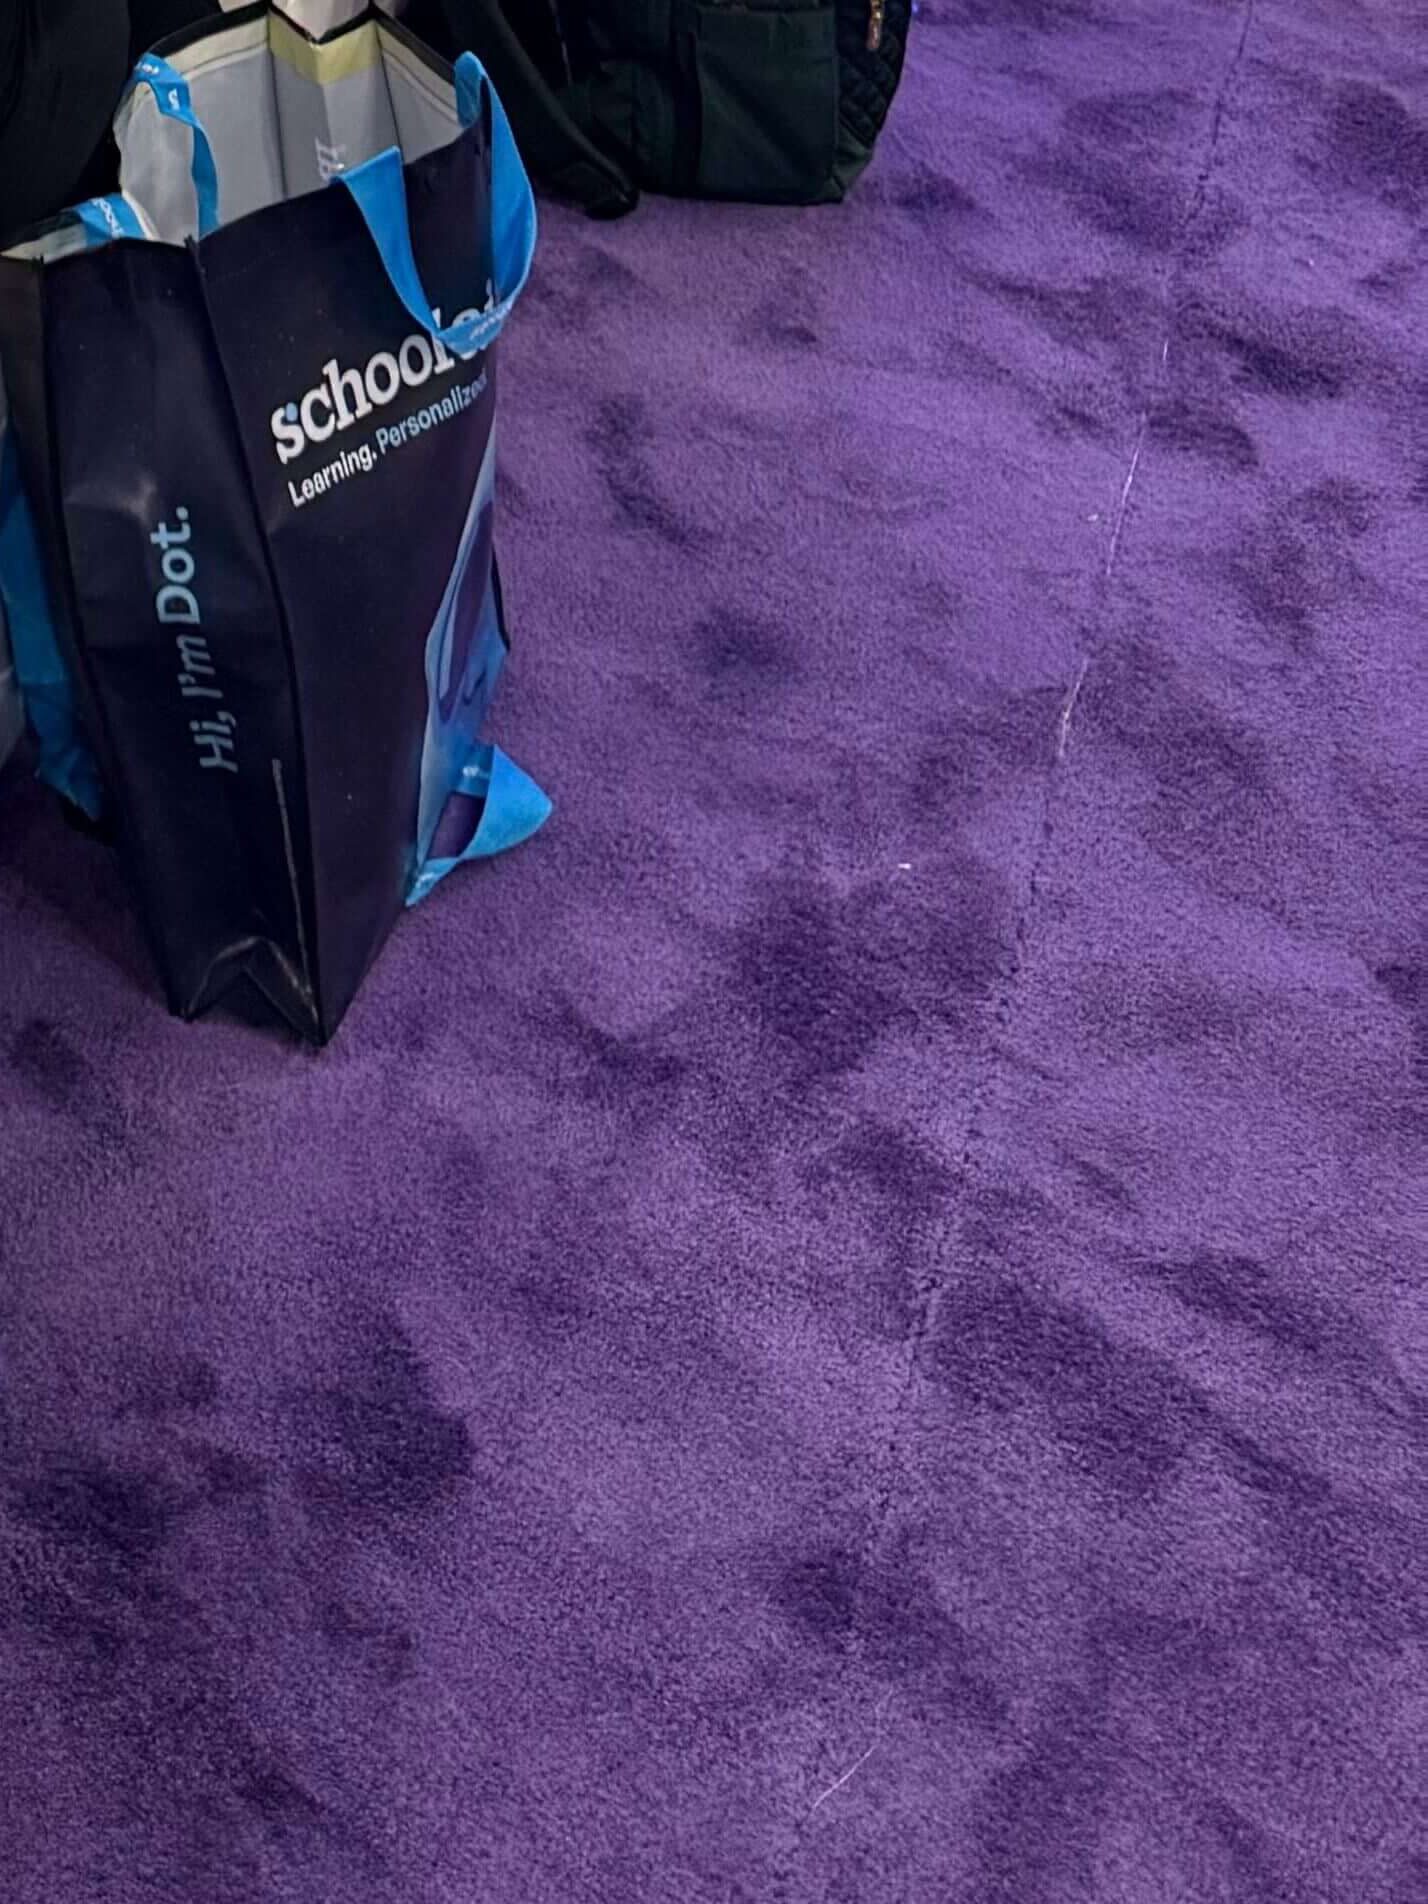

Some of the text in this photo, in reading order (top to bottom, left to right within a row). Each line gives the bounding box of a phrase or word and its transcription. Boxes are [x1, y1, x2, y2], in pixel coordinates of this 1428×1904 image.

[288, 443, 378, 508] Learning.
[150, 506, 201, 624] Dot.
[190, 710, 239, 773] Hi,
